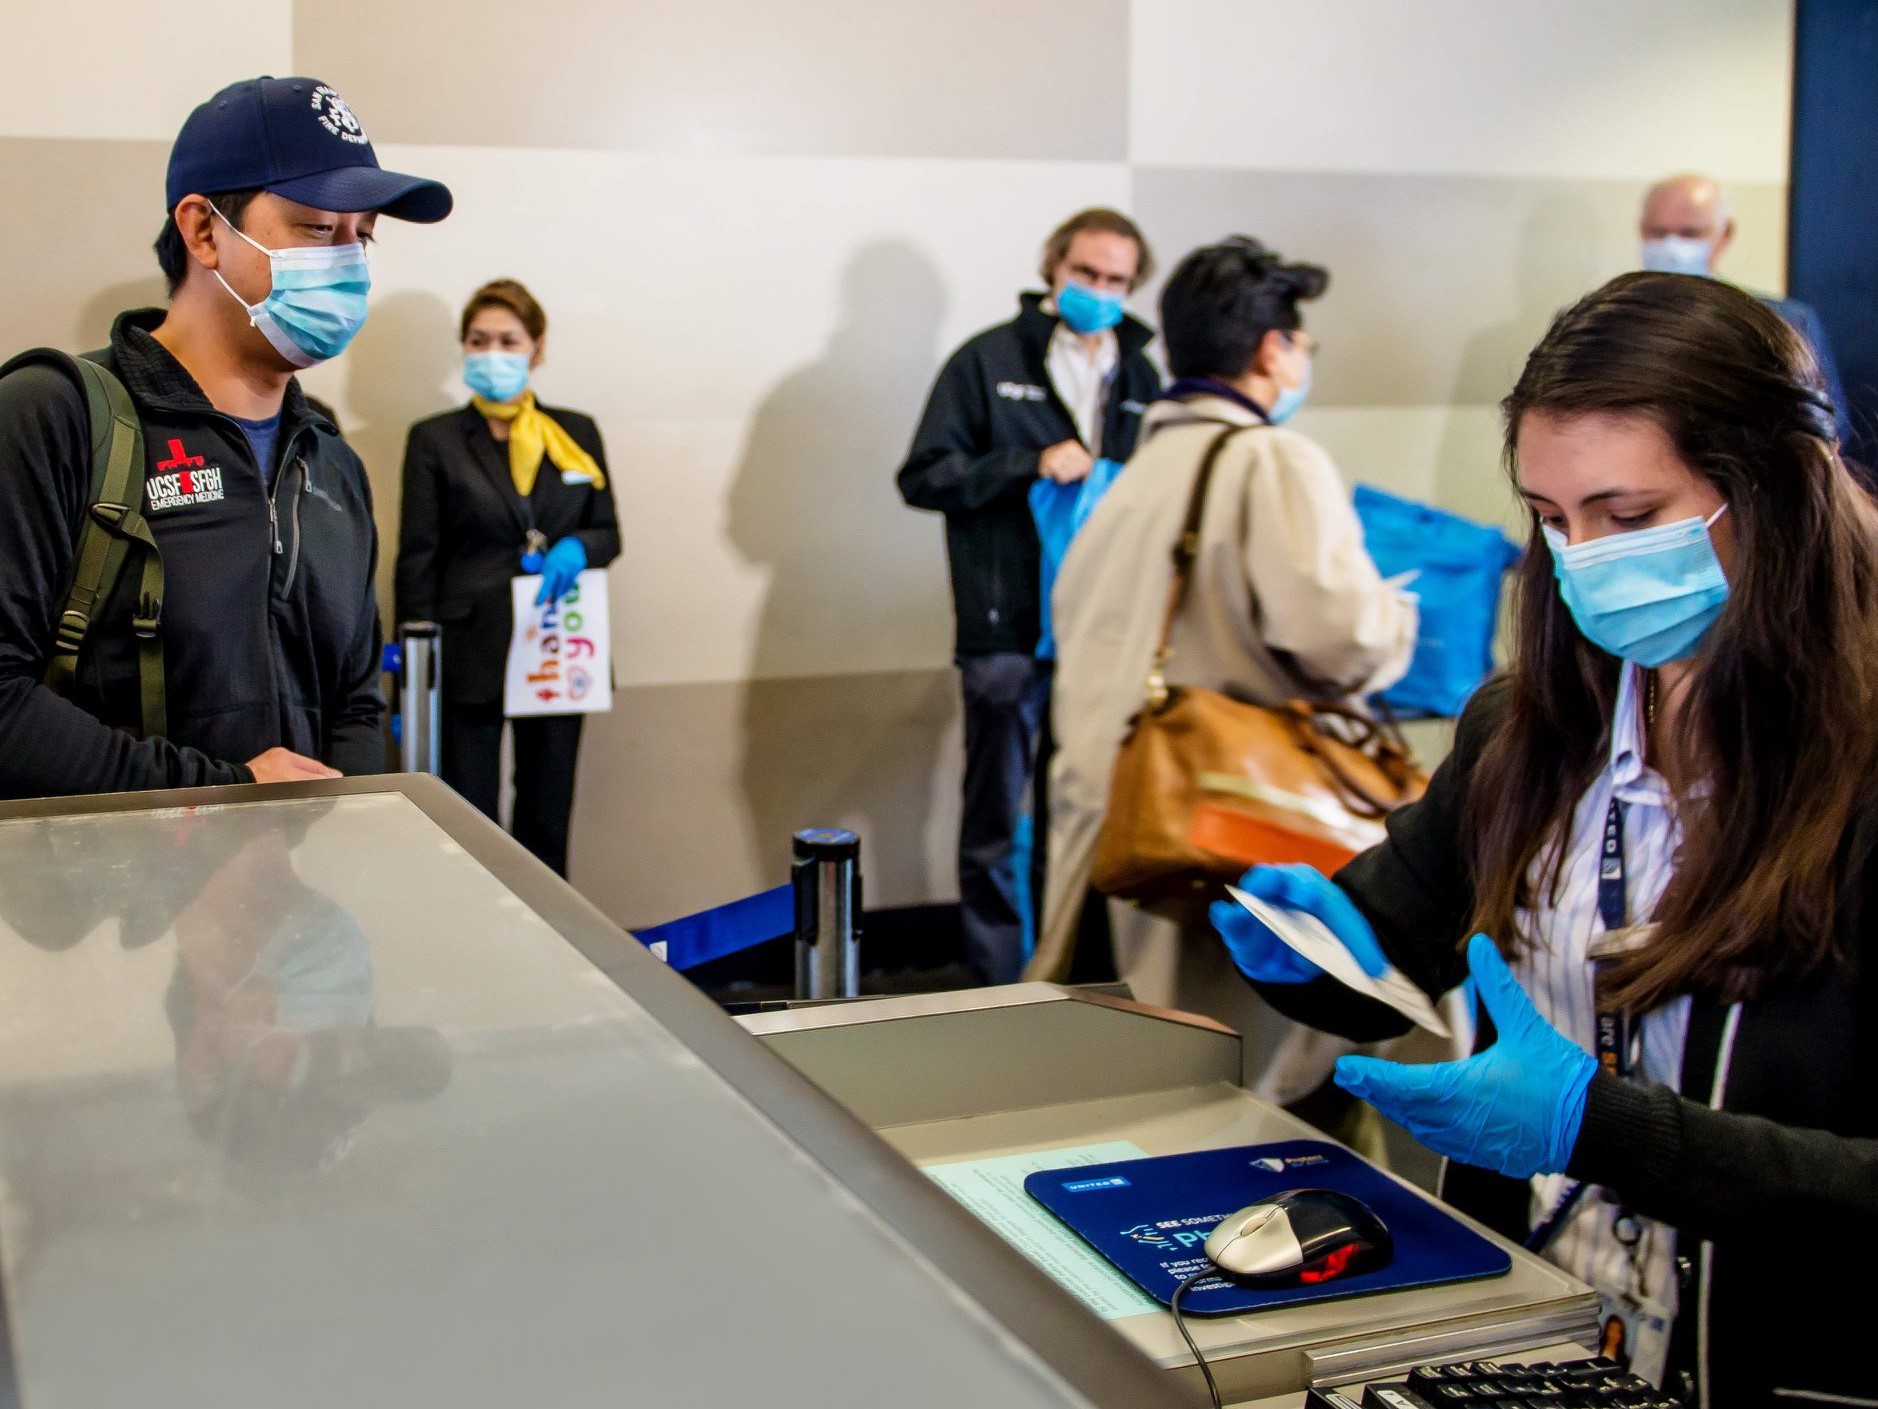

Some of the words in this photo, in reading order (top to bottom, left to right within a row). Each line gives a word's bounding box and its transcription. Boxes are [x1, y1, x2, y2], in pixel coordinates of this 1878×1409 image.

[317, 115, 340, 135] FIRE
[147, 475, 181, 499] UCSF
[190, 468, 222, 492] SFGH
[151, 494, 195, 510] EMERGENCY
[195, 489, 224, 503] MEDICINE
[526, 597, 560, 703] than
[1069, 1181, 1111, 1190] UNITED
[1156, 1220, 1182, 1229] SEE
[1181, 1213, 1234, 1226] SOMETH
[1173, 1230, 1211, 1248] Ph
[1170, 1260, 1191, 1268] you
